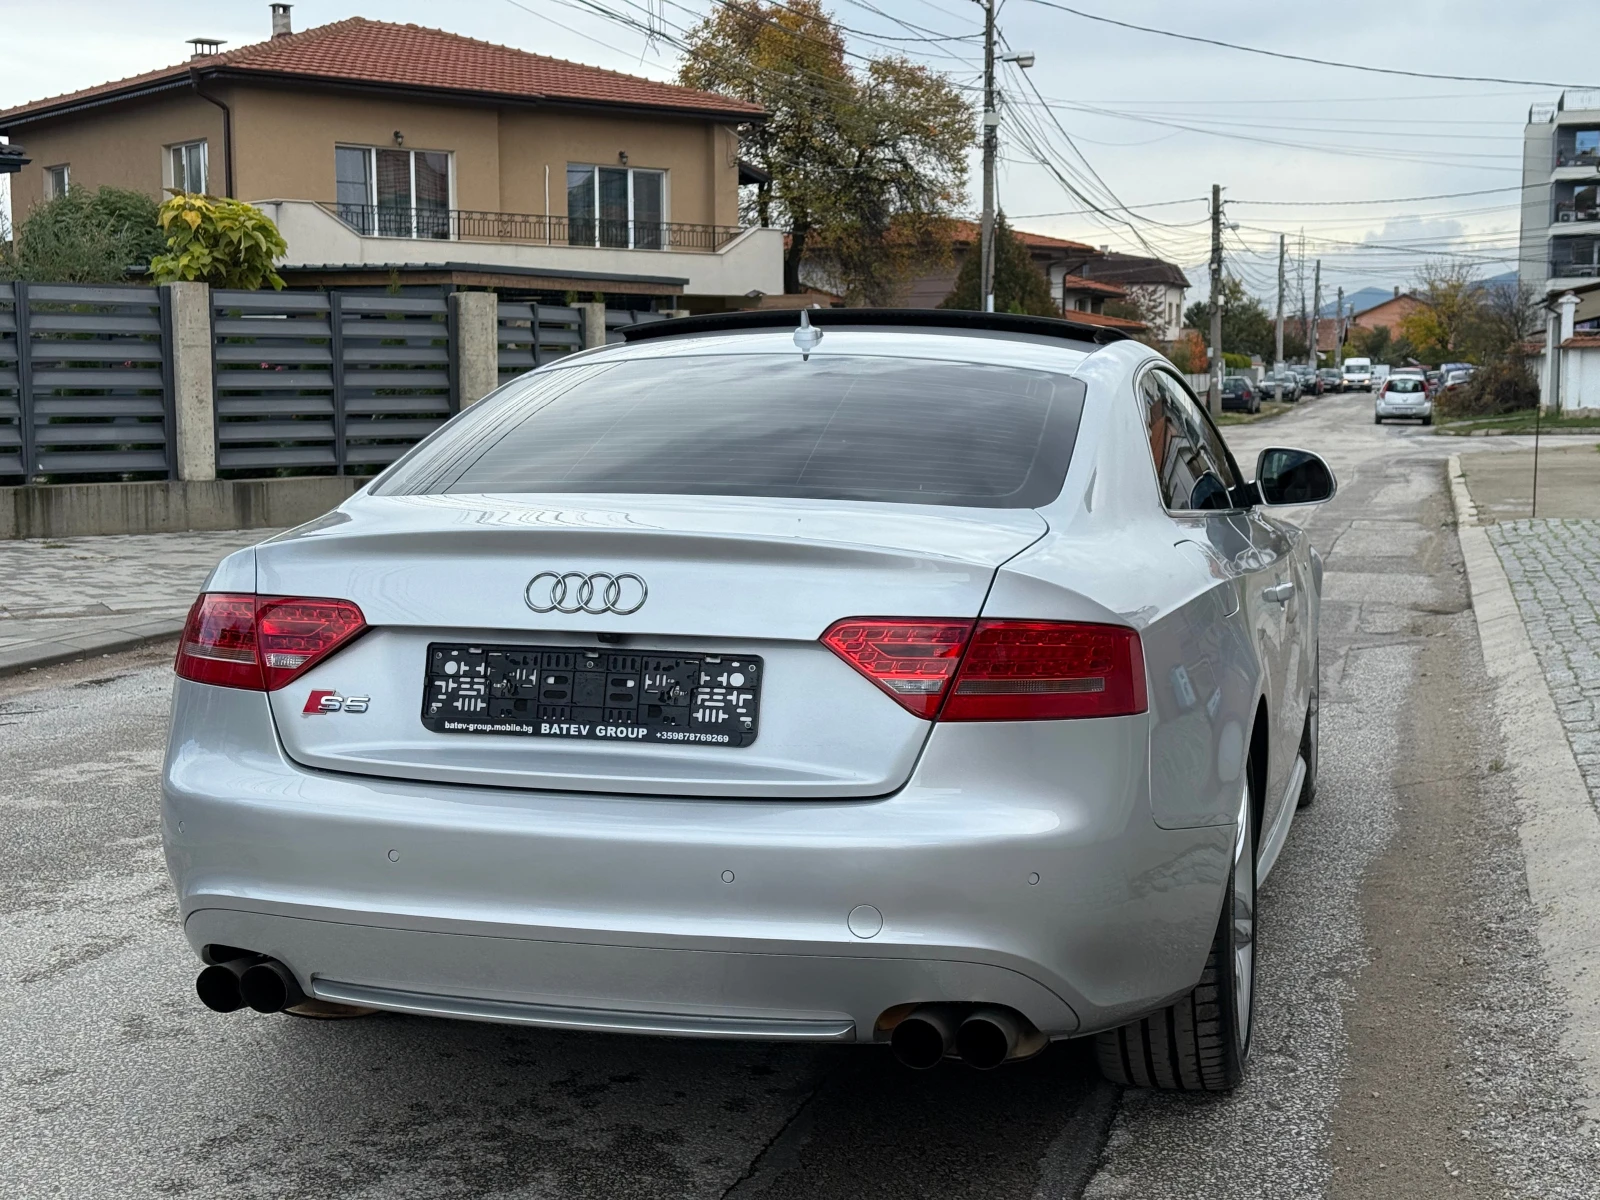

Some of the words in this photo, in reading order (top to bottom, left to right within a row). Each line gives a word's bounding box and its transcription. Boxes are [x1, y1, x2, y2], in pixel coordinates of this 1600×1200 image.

[318, 695, 371, 714] S5
[444, 721, 533, 734] batev-group.mobile.bg
[540, 723, 590, 736] BATEV
[595, 726, 648, 739] GROUP
[656, 731, 730, 743] +359878769269
